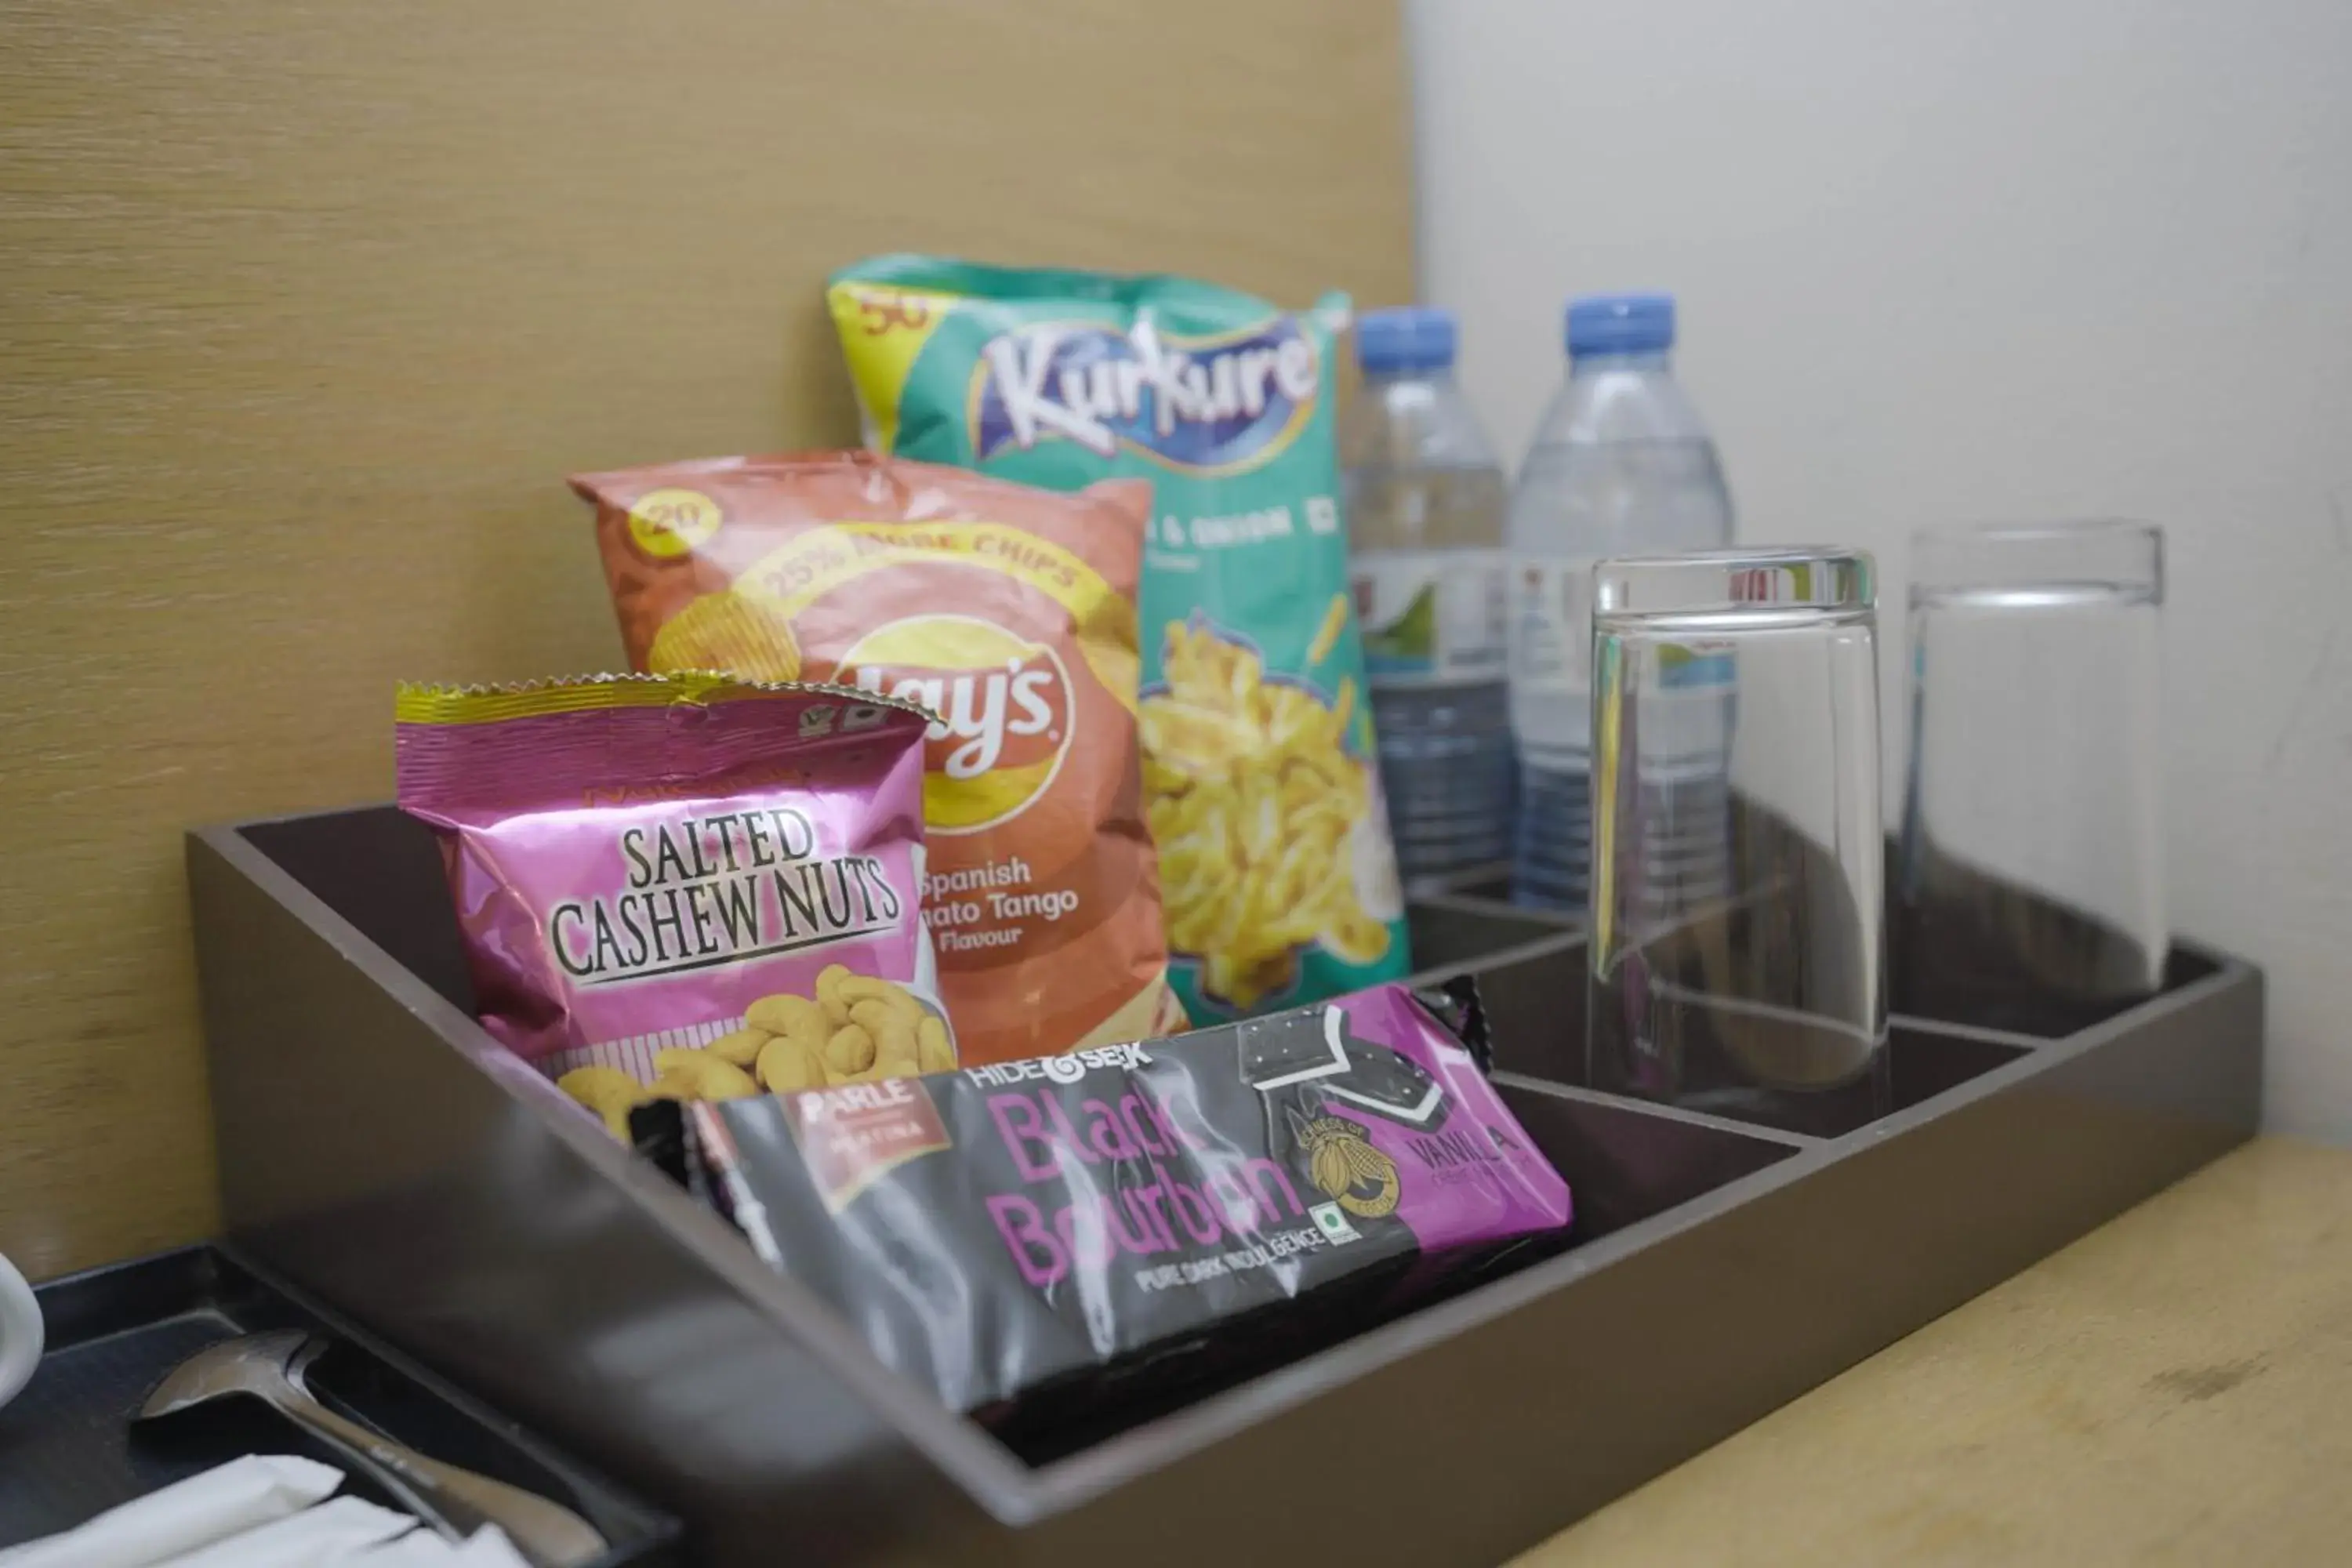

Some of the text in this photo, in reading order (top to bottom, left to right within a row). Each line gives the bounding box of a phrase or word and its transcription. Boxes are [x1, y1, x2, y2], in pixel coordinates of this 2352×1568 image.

[983, 307, 1319, 457] Kurkure
[763, 541, 847, 600] 25%
[973, 533, 1080, 588] CHIPS
[624, 810, 812, 888] SALTED
[551, 857, 898, 977] CASHEW NUTS
[985, 890, 1079, 920] Tango
[939, 928, 1023, 952] Flavour
[798, 1076, 916, 1123] PARLE
[964, 1059, 1047, 1088] HIDE
[985, 1158, 1305, 1287] Bourbon
